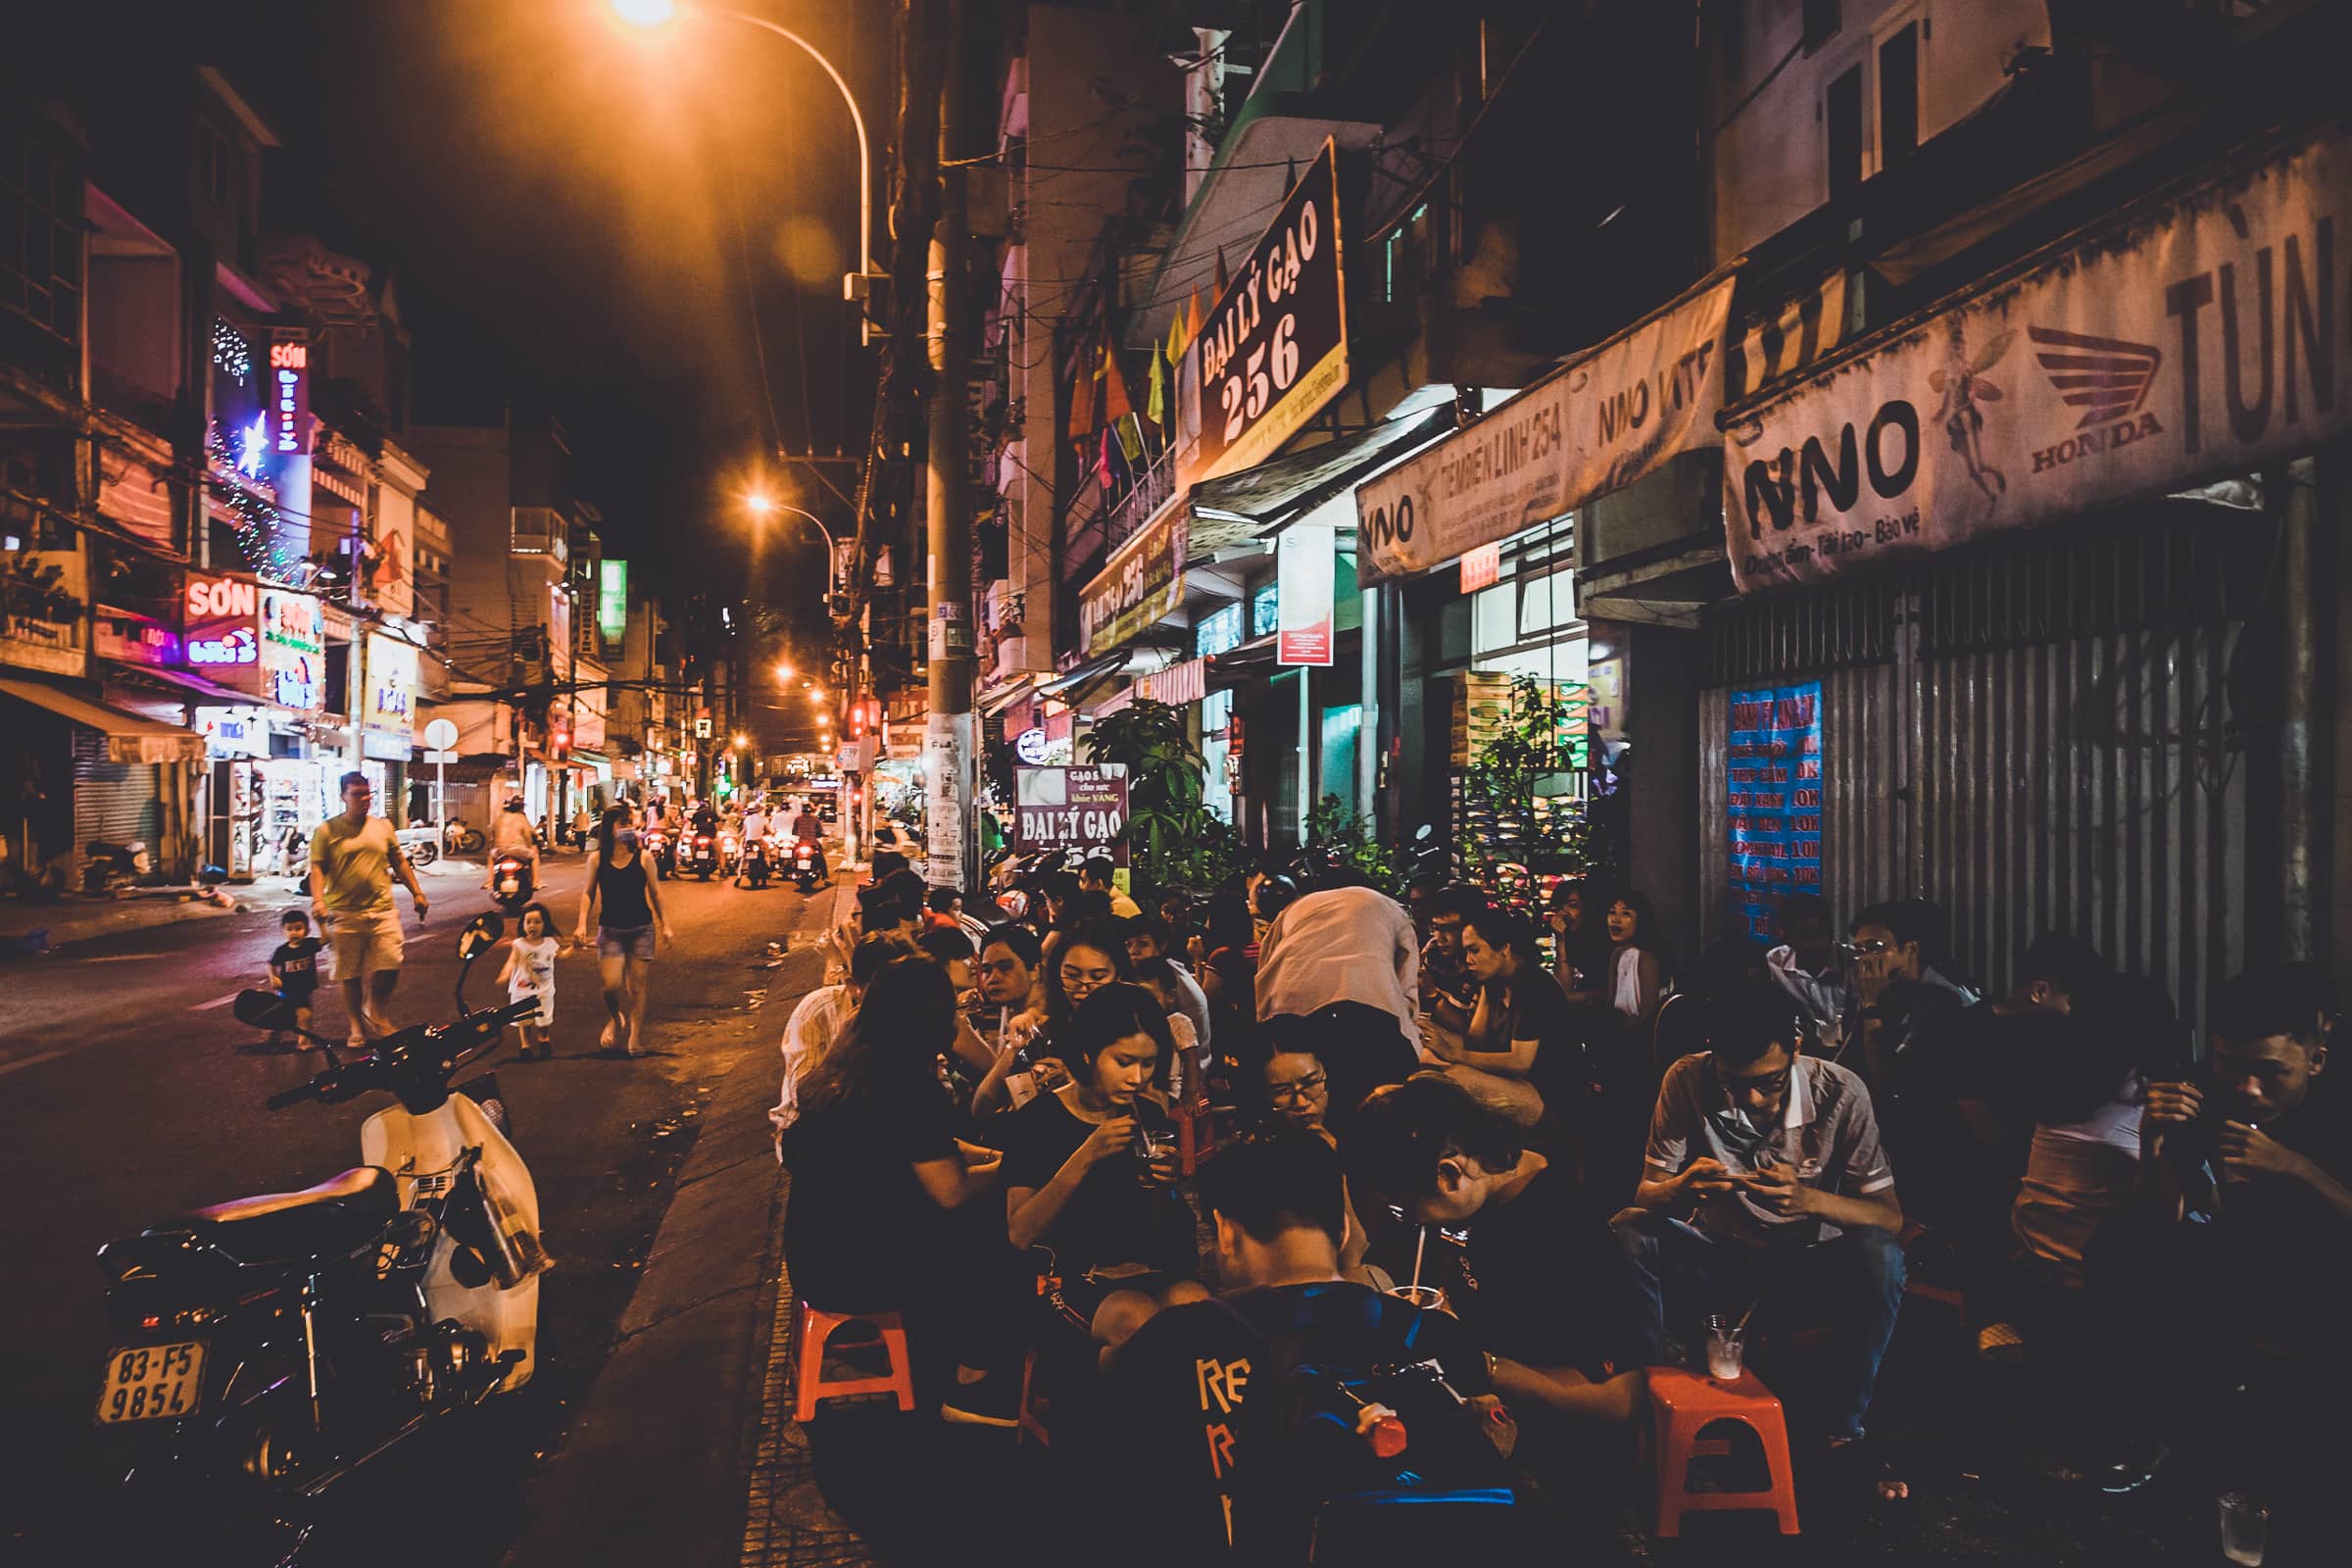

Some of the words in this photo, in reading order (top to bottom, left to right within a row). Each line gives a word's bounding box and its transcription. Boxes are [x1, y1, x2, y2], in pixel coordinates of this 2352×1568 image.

[1204, 308, 1236, 387] ĐẠI
[1237, 260, 1261, 344] LÝ
[1267, 200, 1318, 303] GẠO
[2166, 202, 2352, 455] TÙN
[1222, 314, 1299, 448] 256
[1533, 402, 1561, 461] 254
[2032, 413, 2164, 474] HONDA
[1744, 400, 1921, 540] NNO
[1875, 514, 1901, 544] Bảo
[1902, 506, 1921, 536] vệ
[188, 578, 255, 616] SƠN
[1022, 811, 1054, 845] ĐẠI
[1083, 810, 1122, 844] GẠO
[1791, 840, 1820, 859] 10K
[1793, 866, 1820, 884] 10K
[119, 1344, 195, 1384] 83-F5
[110, 1382, 184, 1420] 9854
